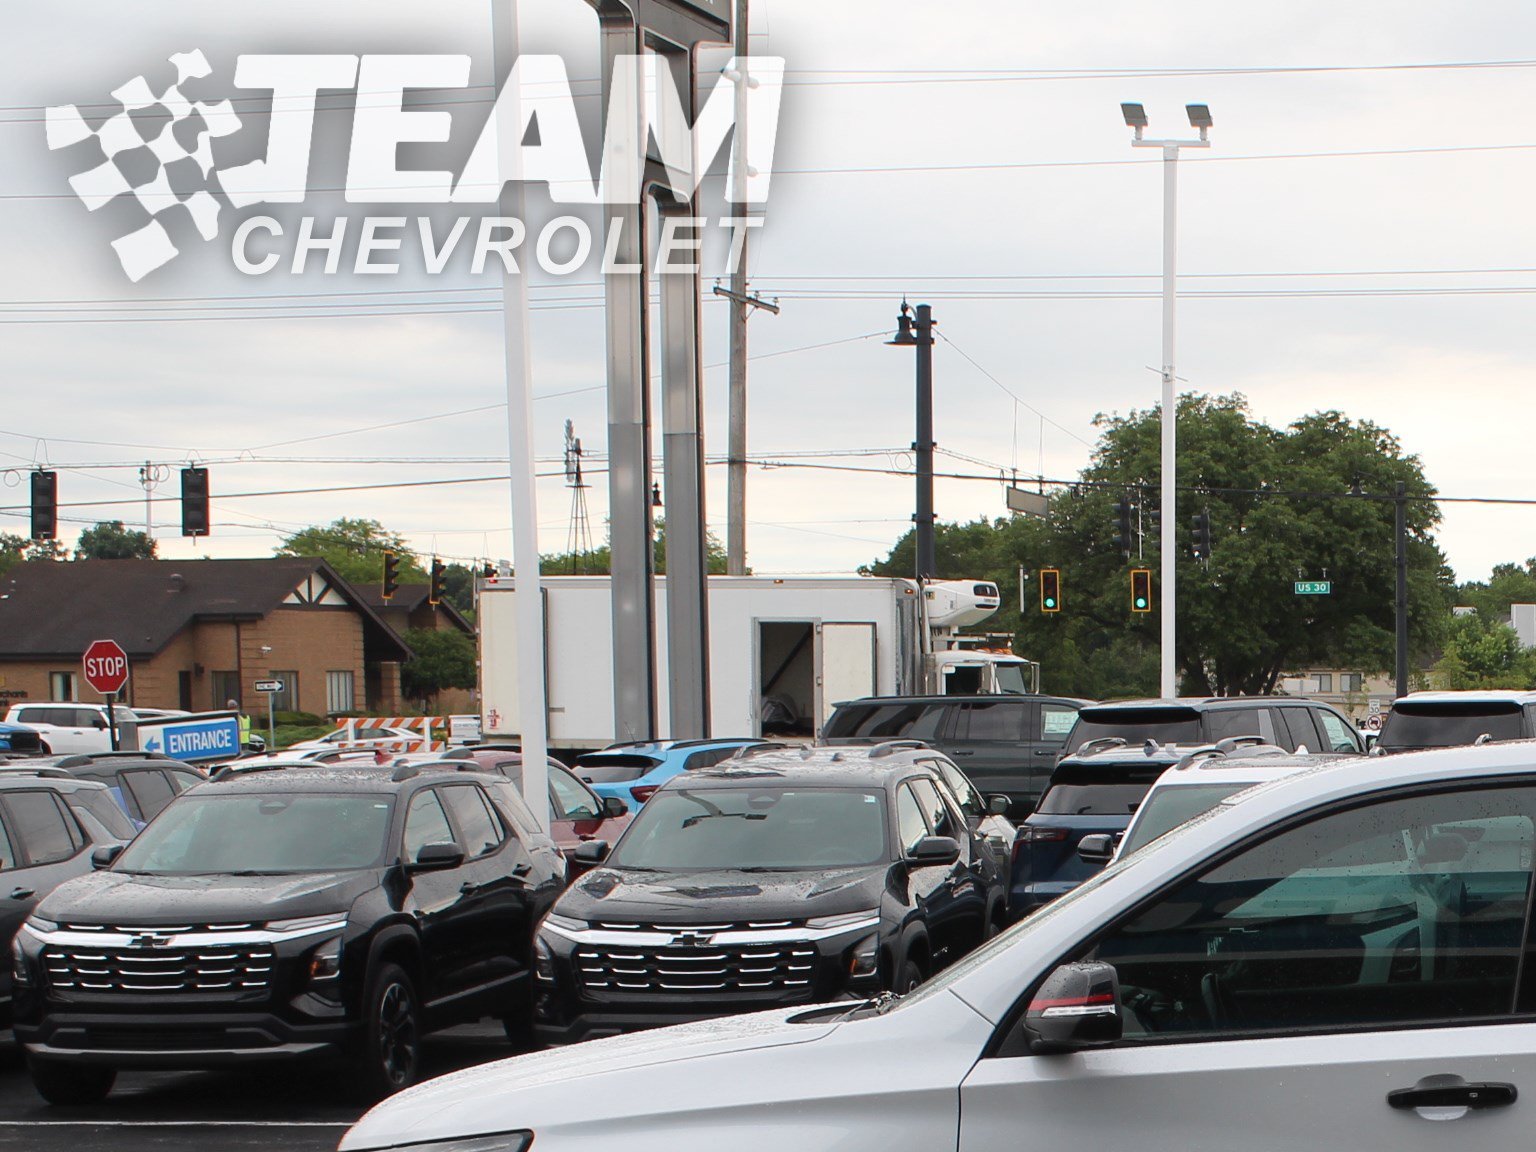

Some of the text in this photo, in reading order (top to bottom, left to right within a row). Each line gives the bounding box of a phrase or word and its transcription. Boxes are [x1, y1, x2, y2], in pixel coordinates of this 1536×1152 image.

[1298, 583, 1326, 591] US 30
[87, 656, 124, 678] STOP
[169, 729, 232, 753] ENTRANCE
